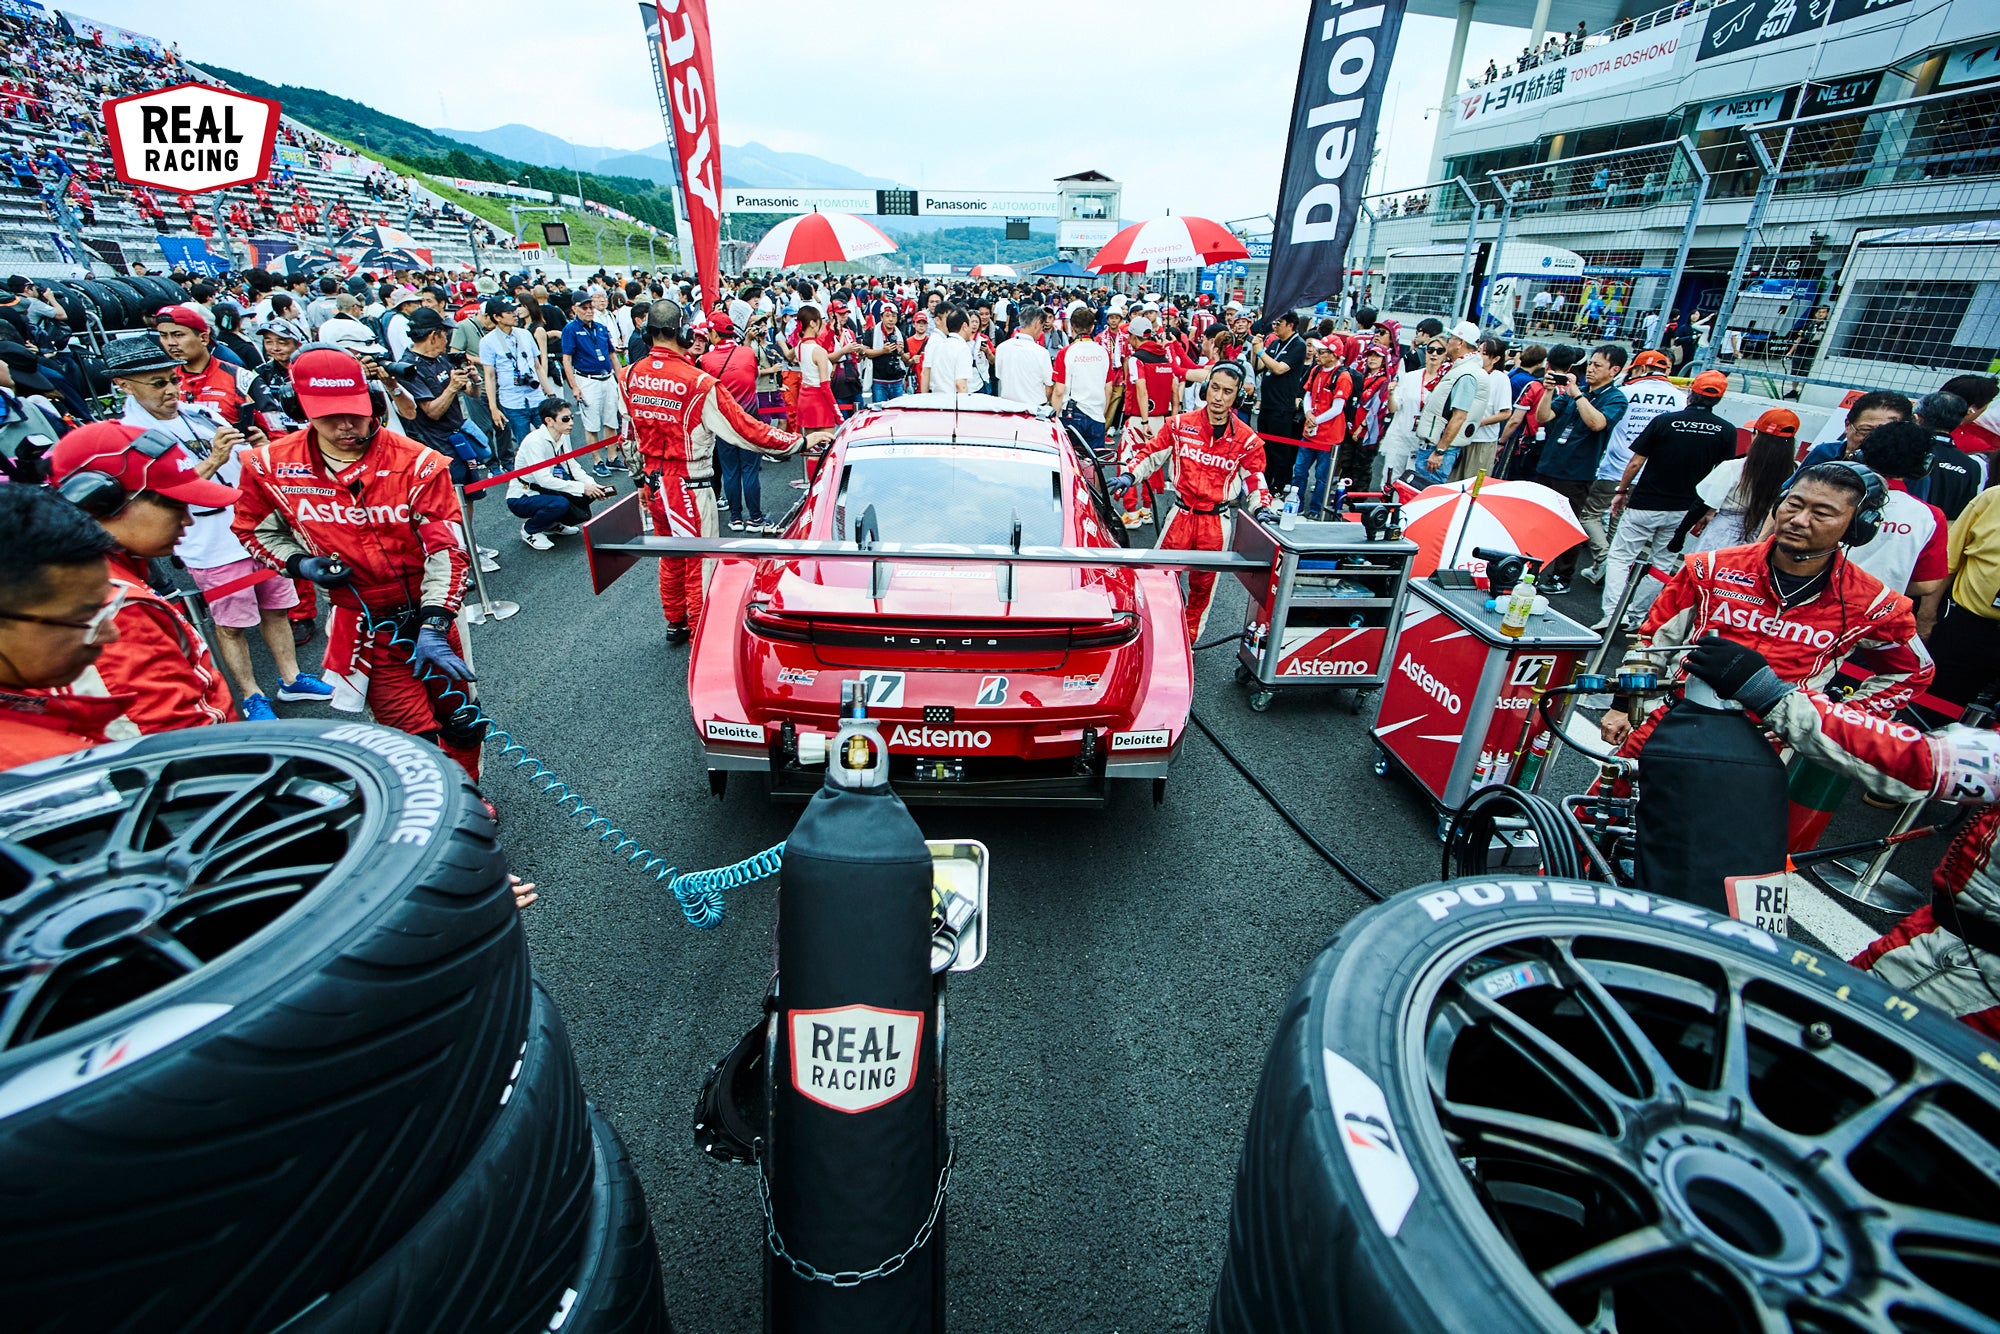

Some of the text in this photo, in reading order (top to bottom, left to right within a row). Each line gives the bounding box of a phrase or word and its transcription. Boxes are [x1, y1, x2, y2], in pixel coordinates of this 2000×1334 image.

[1755, 17, 1794, 41] FUJI
[1482, 38, 1679, 114] トヨタ紡織 TOYOTA BOSHOKU
[1817, 79, 1875, 103] NEXTY
[1727, 96, 1775, 116] NEXTY
[736, 195, 870, 208] Panasonic AUTOMOTIVE
[926, 198, 1057, 211] Panasonic AUTOMOTIVE
[522, 250, 540, 261] 100
[1141, 243, 1183, 255] Astemo
[1074, 354, 1103, 363] Astemo
[309, 377, 356, 387] Astemo
[628, 372, 688, 396] Astemo
[632, 395, 682, 410] BRIDGESTONE
[1629, 393, 1676, 407] ARTA
[634, 409, 679, 424] HONDA
[1671, 420, 1722, 432] CVSTOS
[923, 447, 1023, 461] BOSCH
[1179, 443, 1236, 471] Astemo
[281, 485, 337, 497] BRIDGESTONE
[297, 498, 410, 526] Astemo
[1881, 520, 1912, 535] mo
[1716, 567, 1759, 585] HRC
[1713, 587, 1765, 606] BRIDGESTONE
[1710, 601, 1834, 649] Astemo
[884, 635, 997, 646] Honda
[1284, 657, 1369, 676] Astemo
[866, 675, 903, 703] 17
[1398, 652, 1462, 715] Astemo
[888, 724, 992, 748] Astemo
[320, 723, 445, 846] BRIDGESTONE
[1416, 880, 1779, 954] POTENZA
[811, 1022, 901, 1063] REAL
[811, 1065, 896, 1091] RACING
